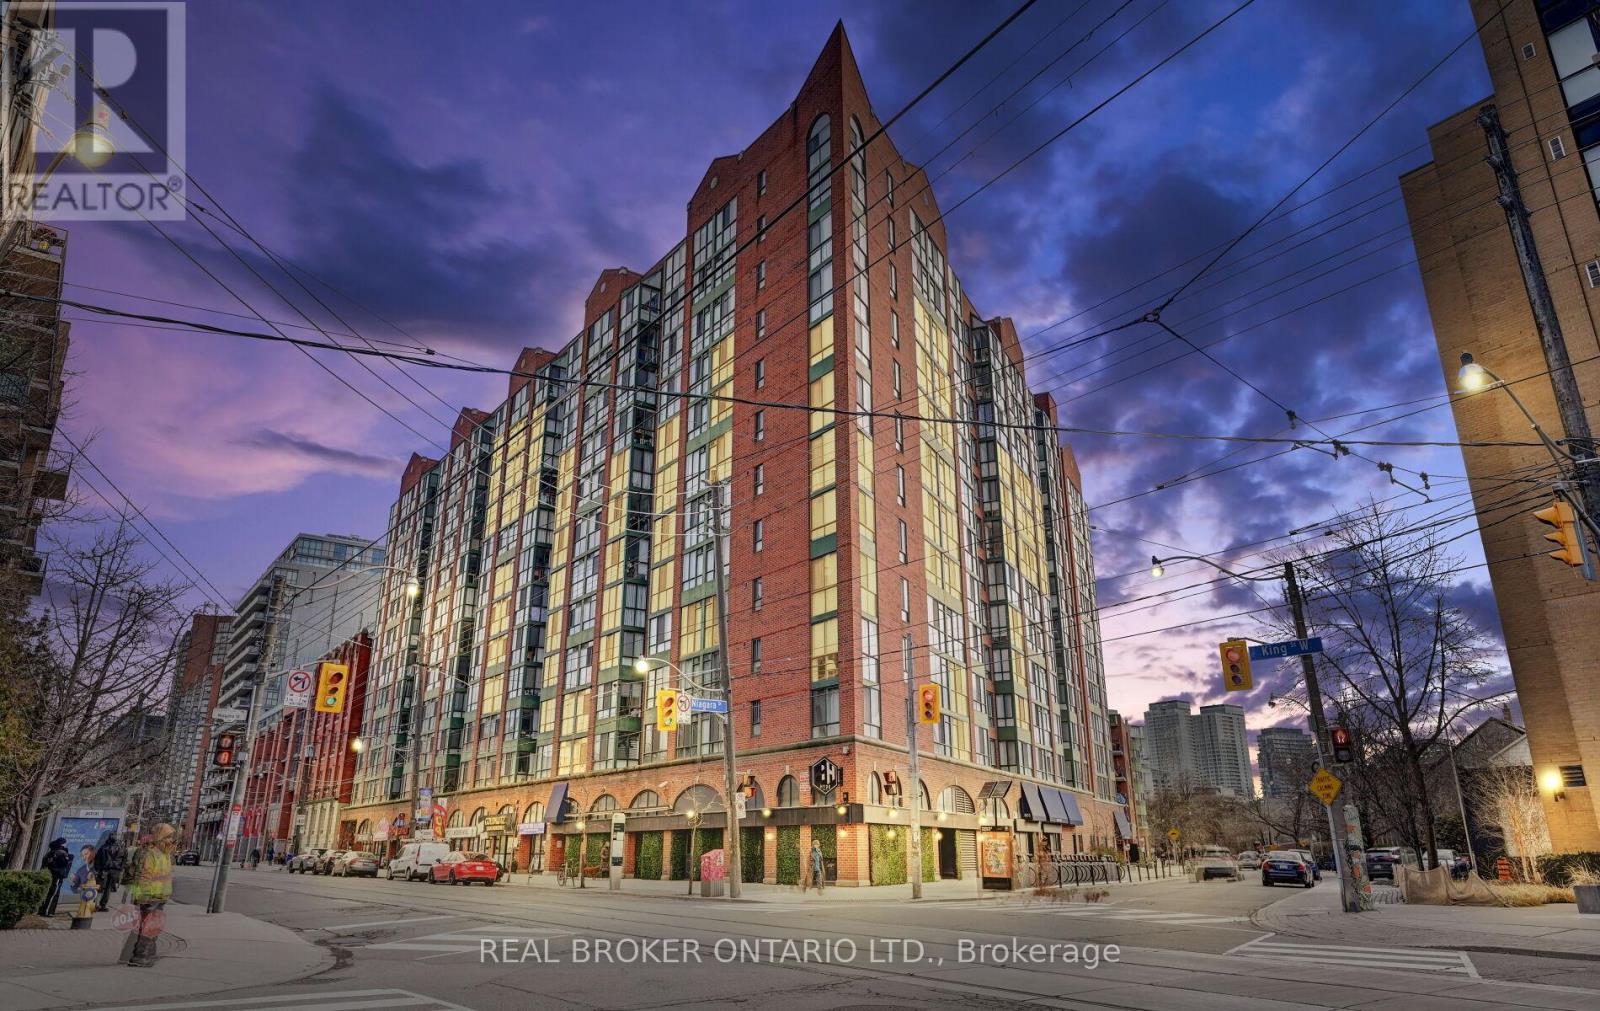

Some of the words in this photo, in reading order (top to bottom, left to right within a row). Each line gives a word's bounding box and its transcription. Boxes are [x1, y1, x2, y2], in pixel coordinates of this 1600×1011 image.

[1261, 645, 1288, 657] King
[1299, 639, 1309, 651] W
[691, 699, 717, 711] Niagara
